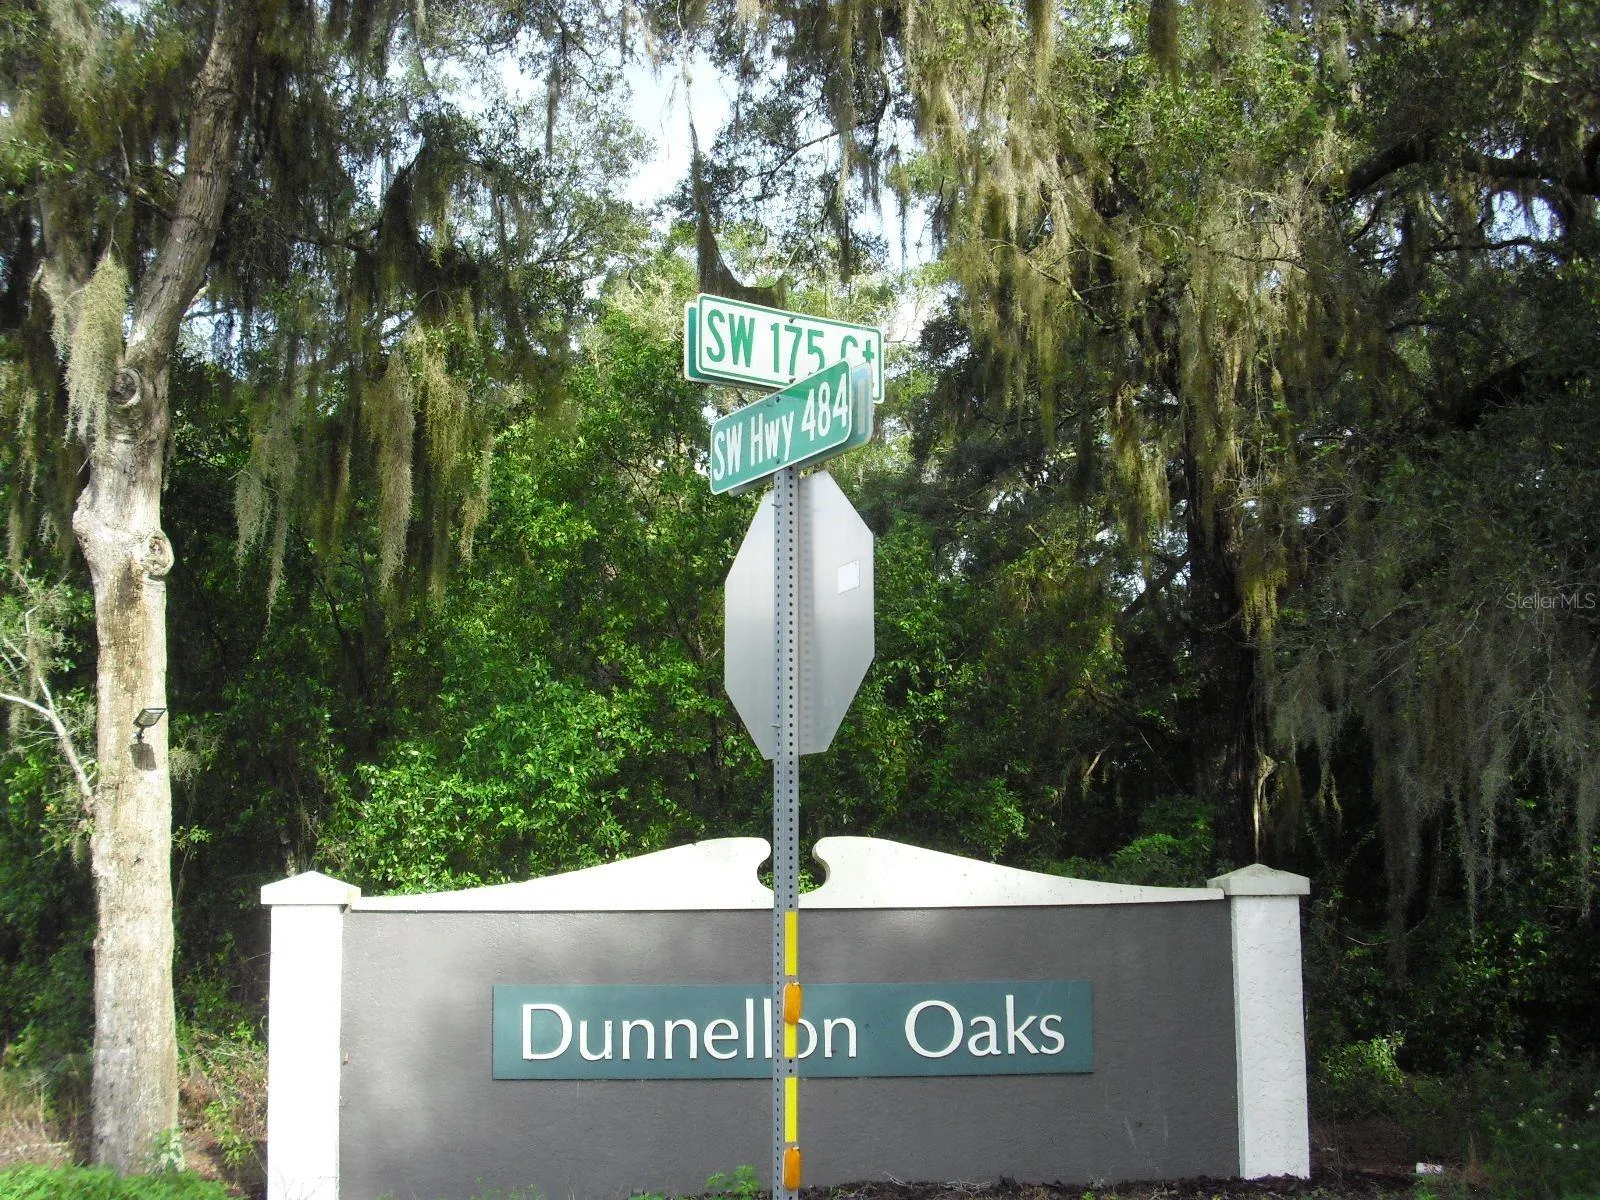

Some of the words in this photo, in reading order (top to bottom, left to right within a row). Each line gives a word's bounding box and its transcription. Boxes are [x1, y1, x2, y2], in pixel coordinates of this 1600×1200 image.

[707, 309, 756, 368] SW
[770, 322, 825, 376] 175
[713, 422, 743, 481] SW
[750, 411, 795, 466] Hwy
[801, 372, 848, 441] 484
[905, 994, 1066, 1058] Oaks
